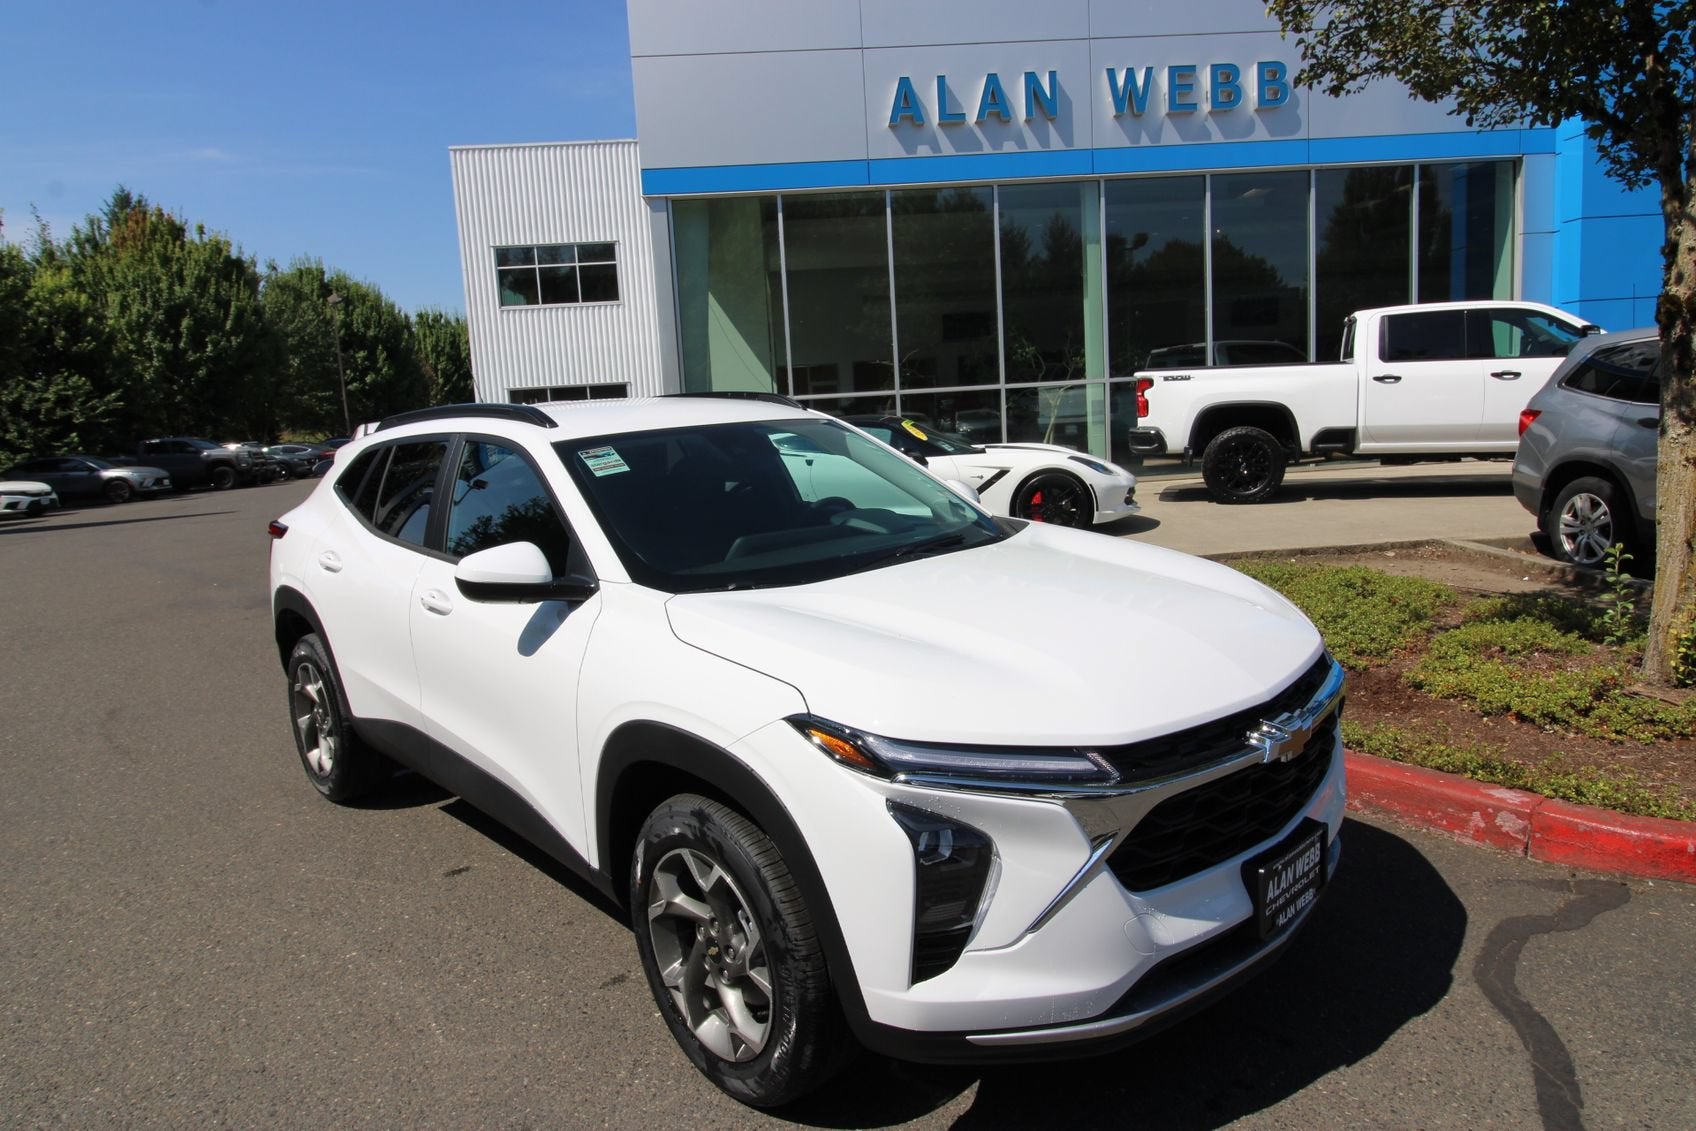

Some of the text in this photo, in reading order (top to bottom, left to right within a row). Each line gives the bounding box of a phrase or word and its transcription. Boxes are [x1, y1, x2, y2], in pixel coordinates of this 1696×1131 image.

[888, 60, 1289, 127] ALAN WEBB
[1265, 865, 1321, 917] CHEVROLET
[1266, 864, 1294, 903] ALAN
[1295, 842, 1321, 879] WEBB
[1278, 903, 1296, 927] ALAN
